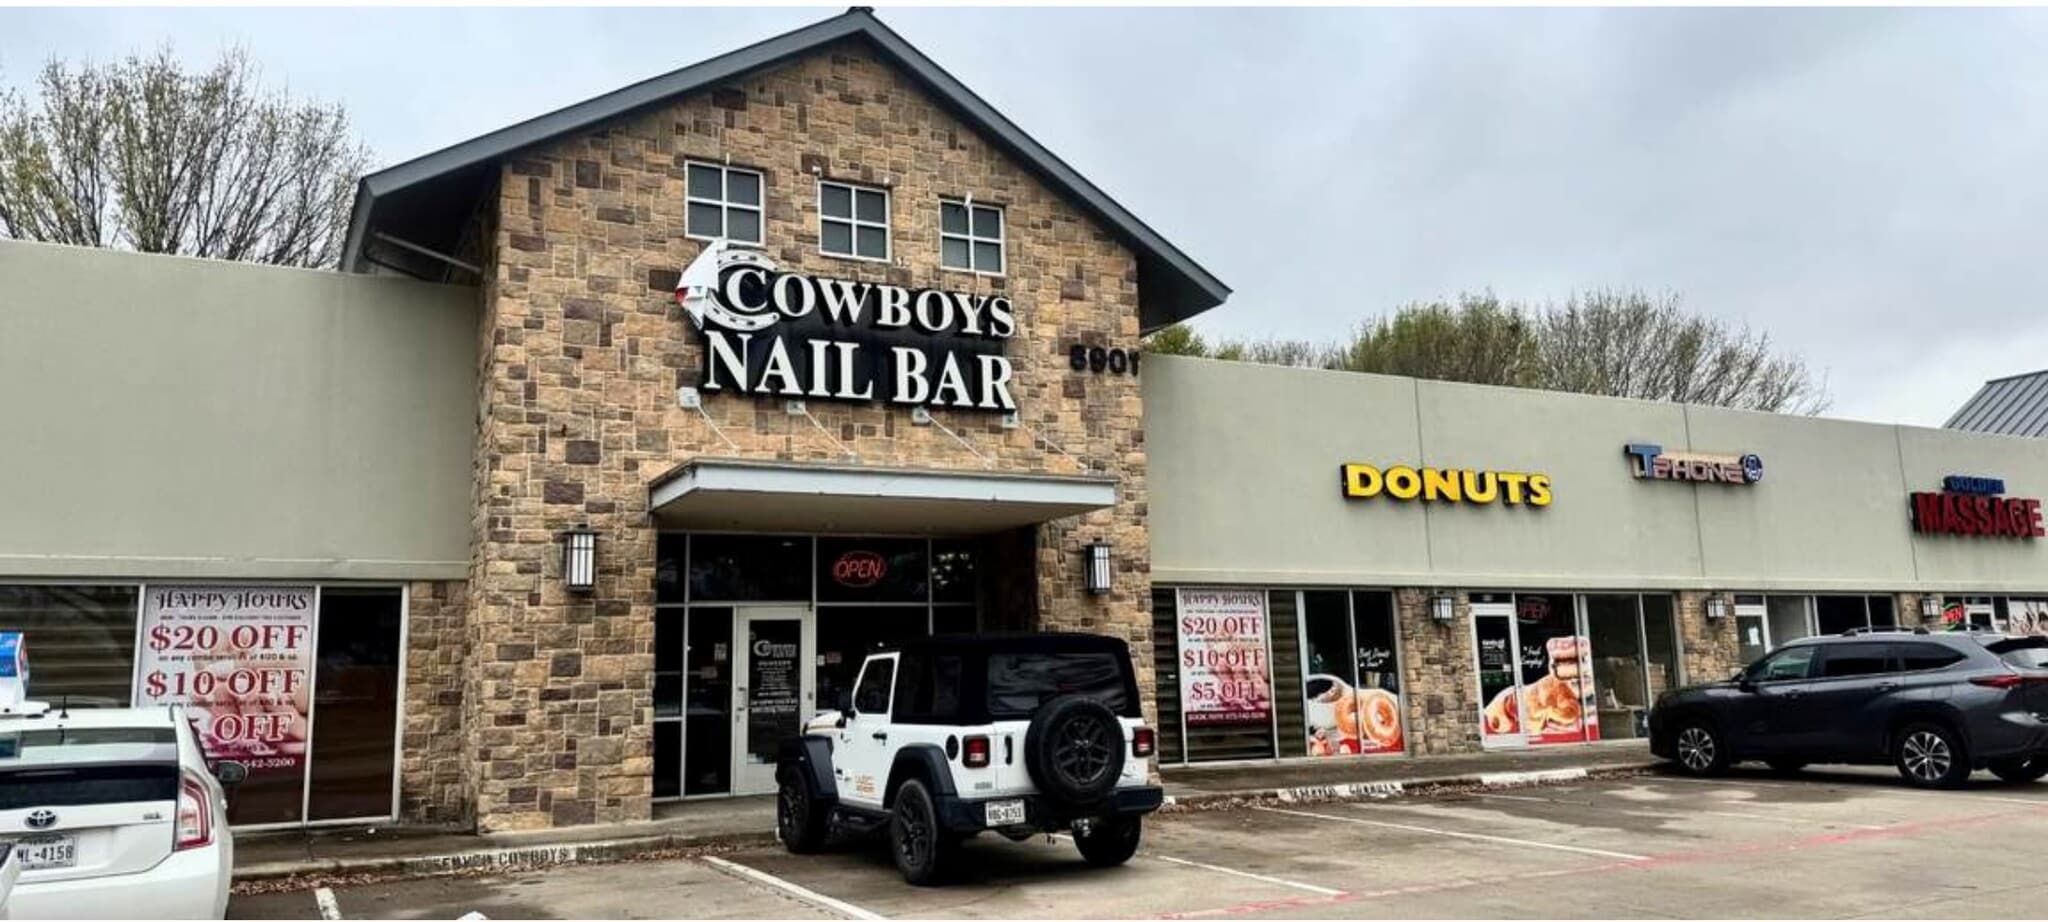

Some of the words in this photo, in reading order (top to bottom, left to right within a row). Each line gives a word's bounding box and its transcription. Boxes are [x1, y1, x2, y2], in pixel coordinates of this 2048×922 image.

[726, 268, 1015, 338] COWBOYS
[704, 330, 873, 399] NAIL
[892, 346, 1016, 410] BAR
[1343, 463, 1552, 506] DONUTS
[1911, 492, 2045, 537] MASSAGE
[835, 558, 881, 579] OPEN
[156, 590, 229, 611] HAPPY
[234, 590, 307, 610] HOURS
[150, 623, 219, 654] $20
[231, 625, 308, 650] OFF
[1182, 615, 1217, 636] $20
[1224, 616, 1263, 635] OFF
[1184, 648, 1218, 668] $10
[1226, 648, 1264, 667] OFF
[146, 669, 216, 700] $10
[228, 669, 304, 696] OFF
[1192, 681, 1215, 701] $5
[1222, 681, 1259, 700] OFF
[215, 715, 293, 742] OFF
